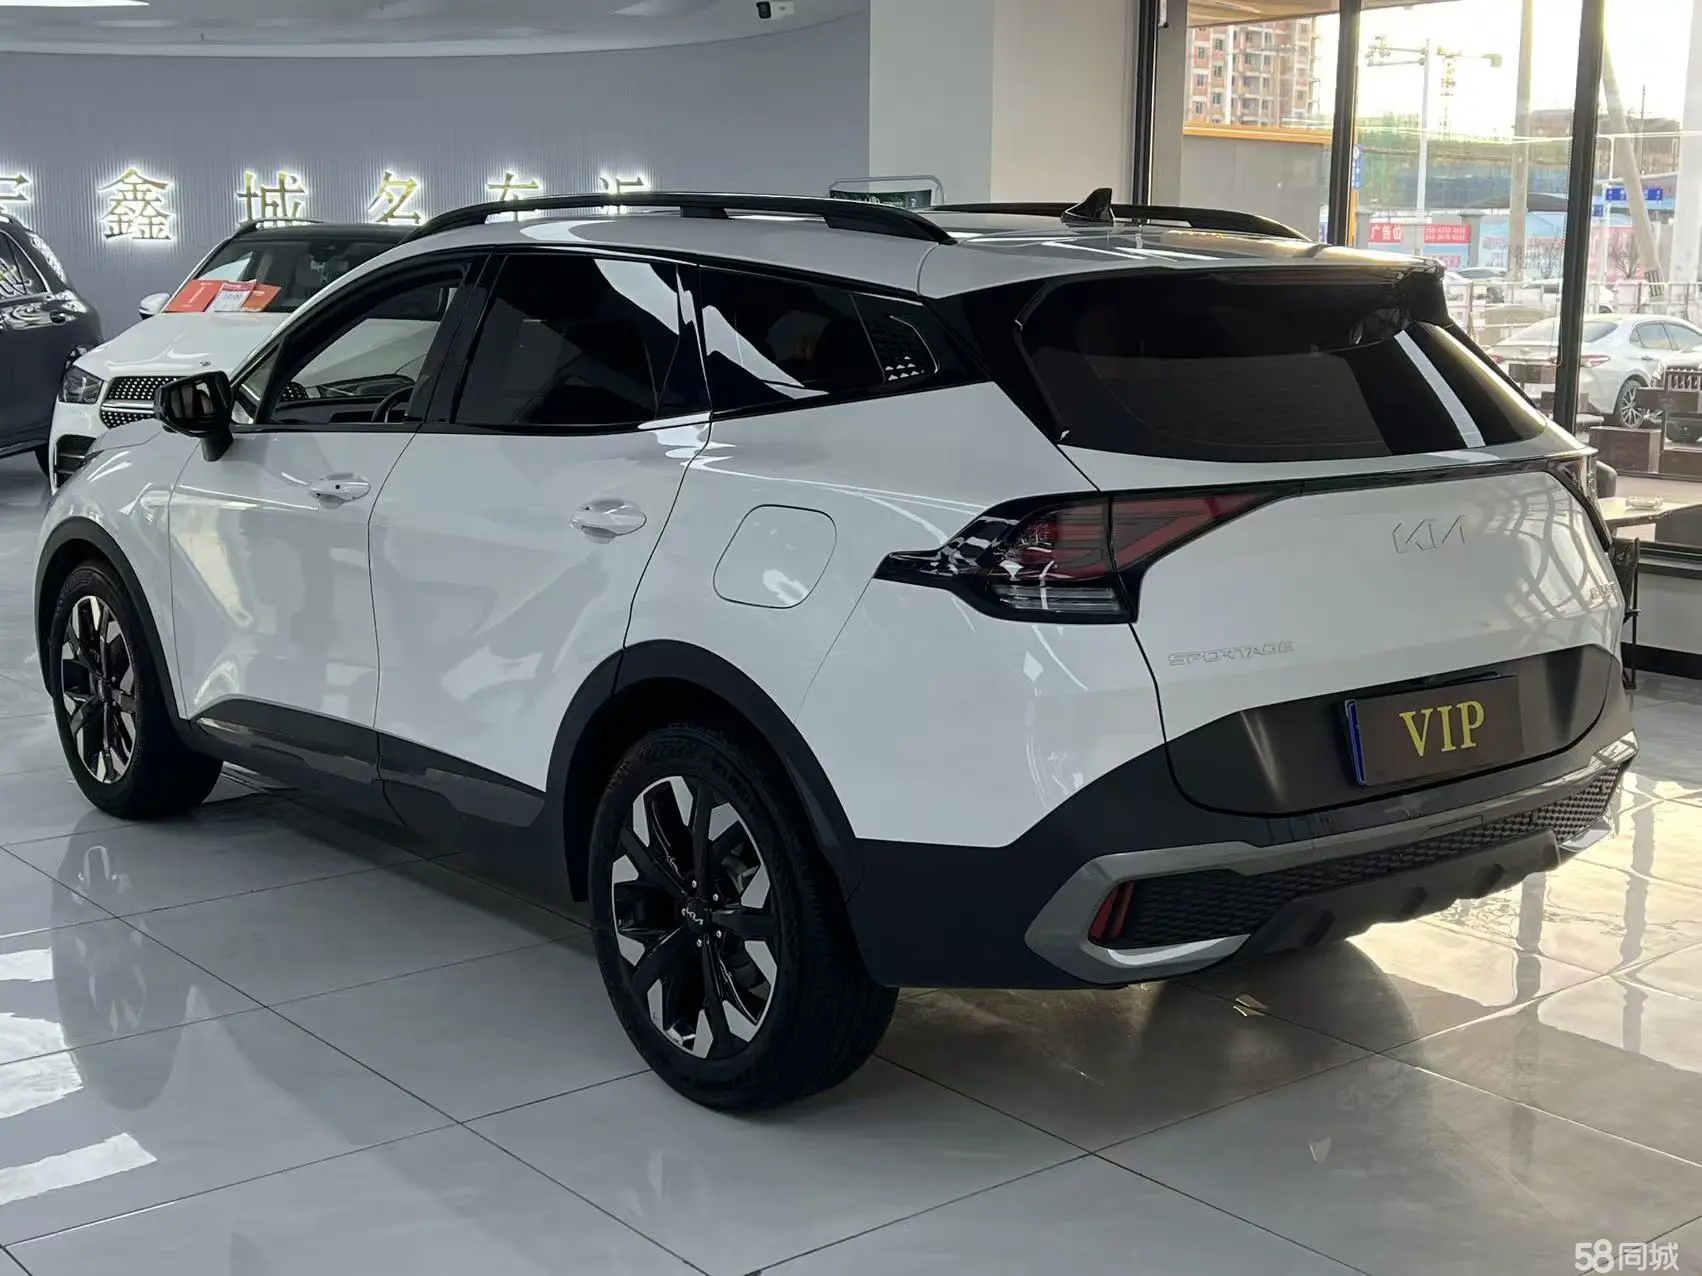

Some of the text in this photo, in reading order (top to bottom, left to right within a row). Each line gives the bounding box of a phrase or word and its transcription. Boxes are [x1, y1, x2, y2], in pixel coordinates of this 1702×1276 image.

[1392, 514, 1467, 554] KIA
[1167, 640, 1296, 666] SPORTAGE
[1398, 699, 1486, 757] VIP
